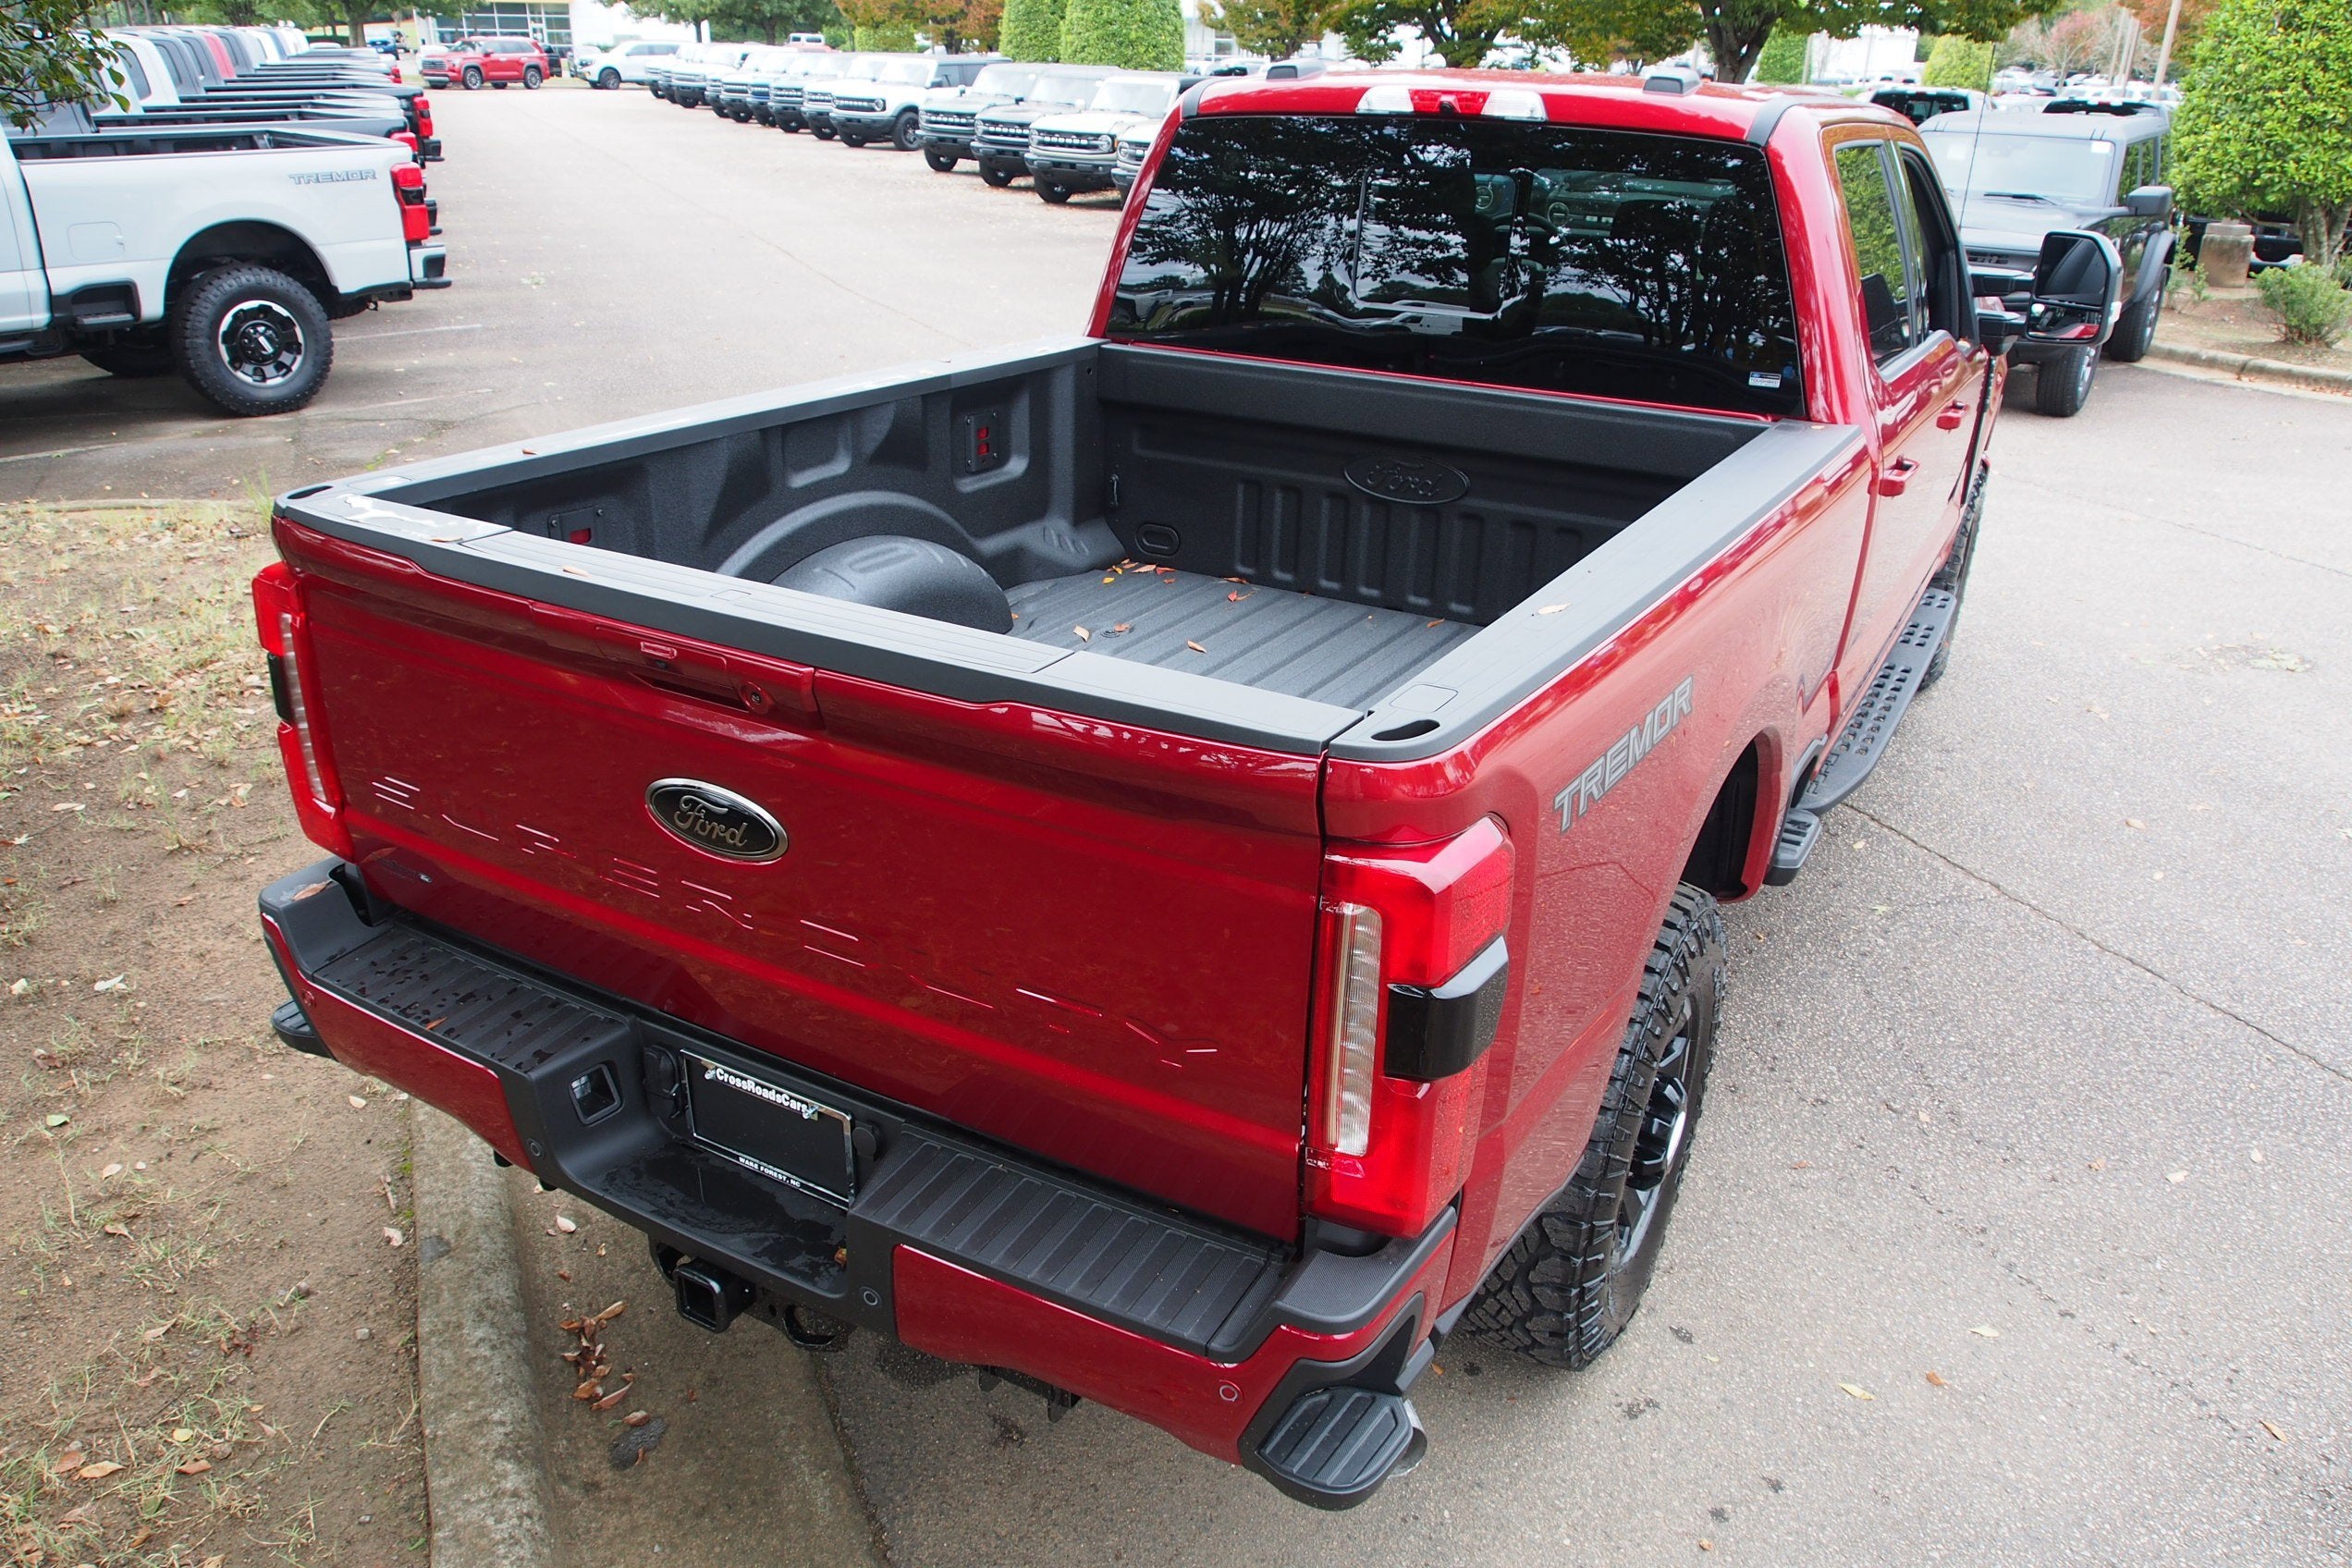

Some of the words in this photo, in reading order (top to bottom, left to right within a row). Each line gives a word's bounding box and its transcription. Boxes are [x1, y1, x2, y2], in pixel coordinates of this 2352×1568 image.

[288, 168, 377, 185] TREMOR
[1366, 459, 1443, 496] Ford
[1552, 674, 1694, 835] TREMOR
[674, 795, 748, 847] Ford
[716, 1068, 808, 1113] CrossRoadsCars
[739, 1156, 759, 1170] WAKE
[790, 1178, 802, 1188] NC
